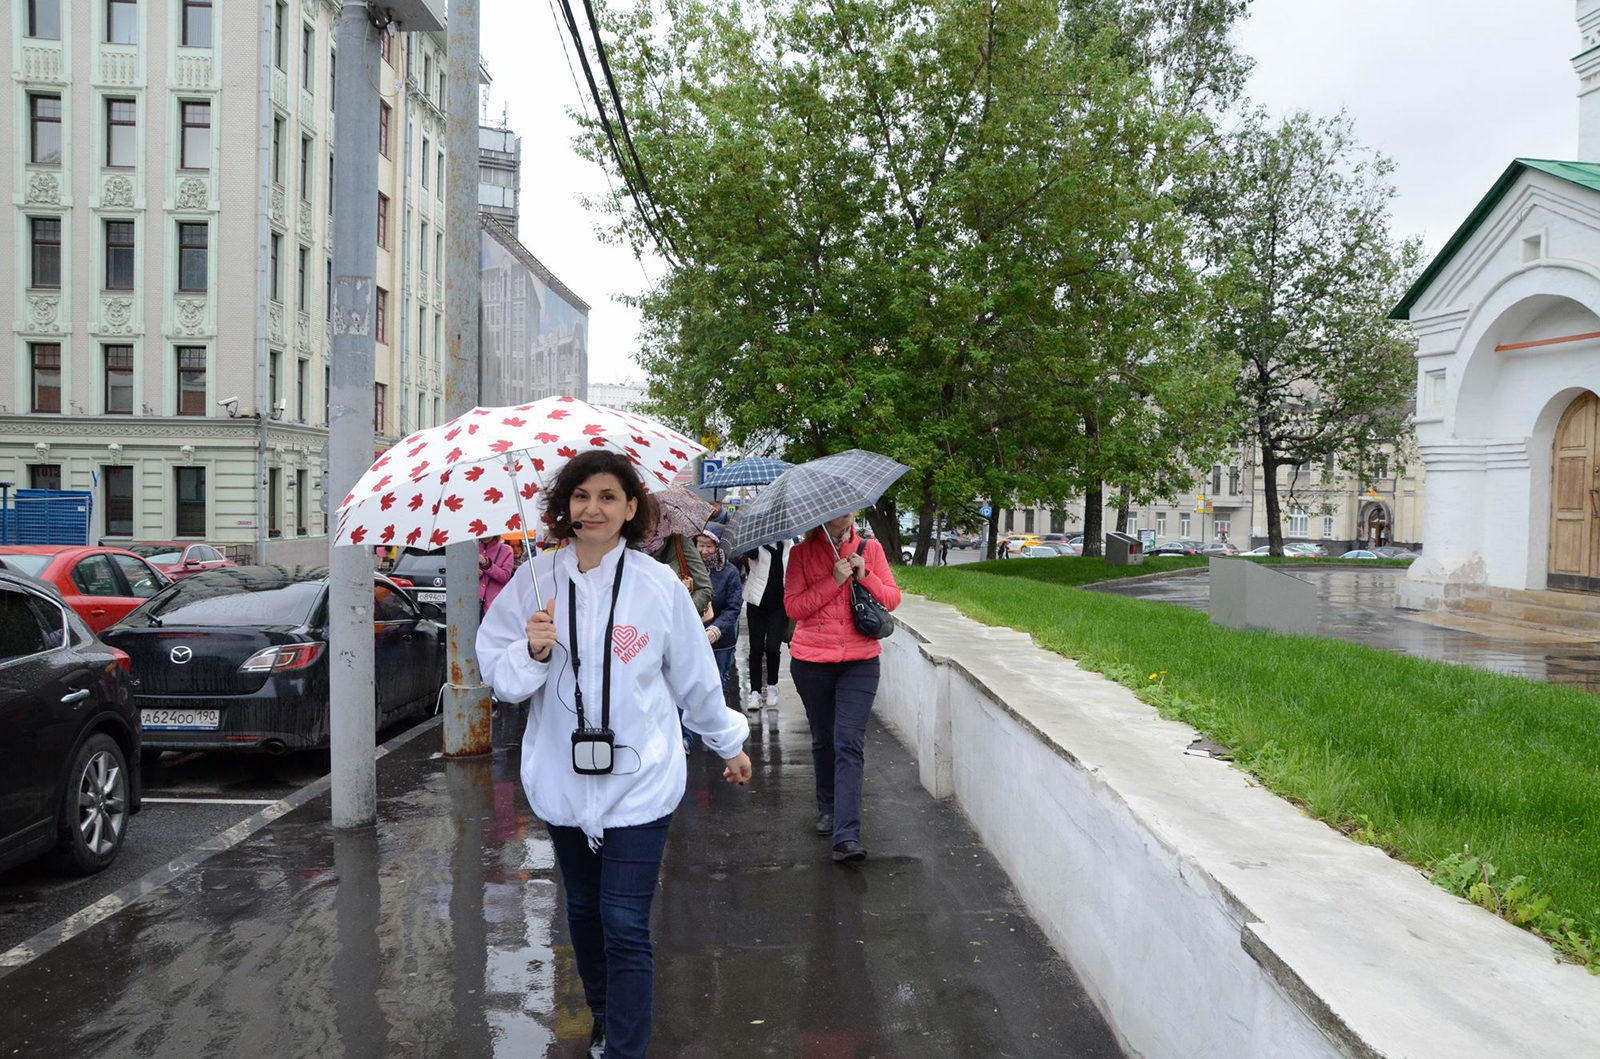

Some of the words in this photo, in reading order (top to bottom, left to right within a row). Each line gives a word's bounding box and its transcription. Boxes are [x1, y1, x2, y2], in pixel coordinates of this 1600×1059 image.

[703, 462, 718, 483] P
[613, 646, 623, 657] Я
[620, 632, 650, 664] МОСКВУ
[197, 710, 215, 721] 190
